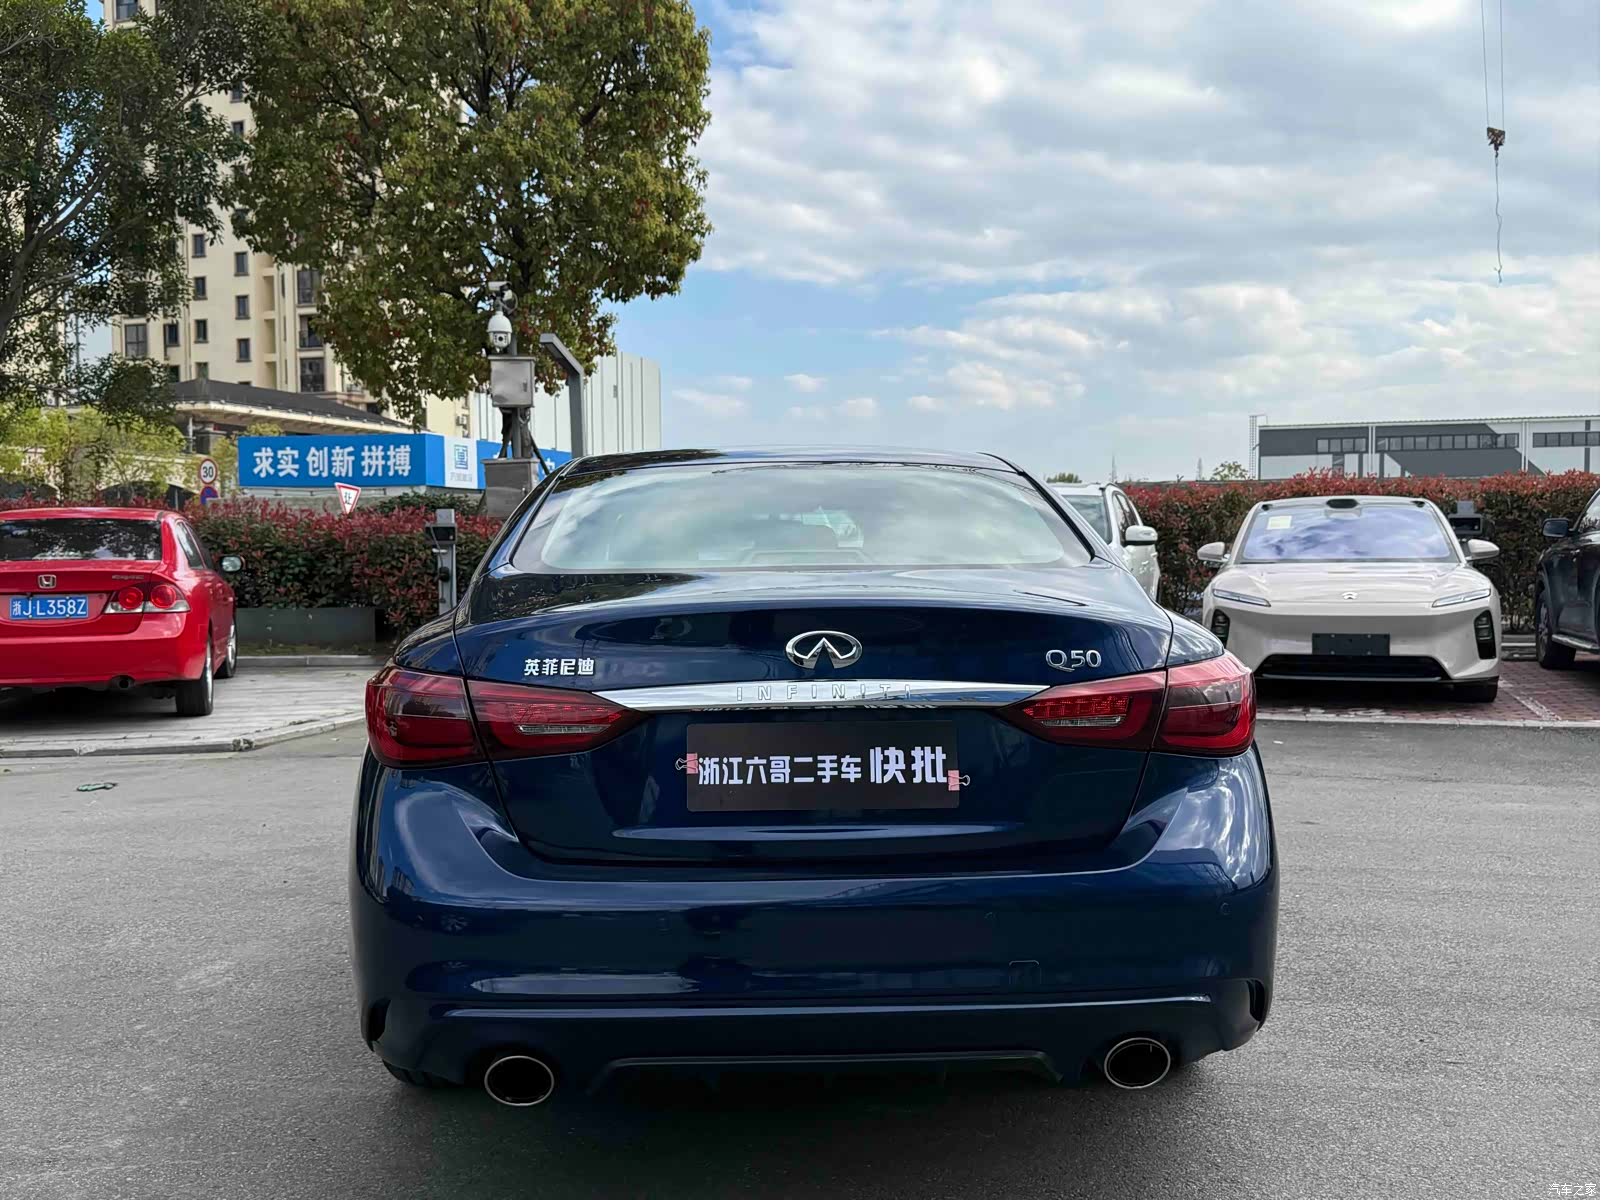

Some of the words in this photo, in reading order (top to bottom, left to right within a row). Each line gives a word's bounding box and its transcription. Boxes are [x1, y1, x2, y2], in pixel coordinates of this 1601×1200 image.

[253, 446, 300, 478] 求实
[306, 446, 355, 478] 创新
[361, 444, 412, 477] 拼搏
[202, 466, 214, 478] 30
[524, 658, 595, 676] 英菲尼迪
[1045, 649, 1102, 672] Q50
[736, 684, 911, 701] INFINITI
[698, 755, 862, 785] 浙江六哥二手车
[869, 746, 947, 784] 快批
